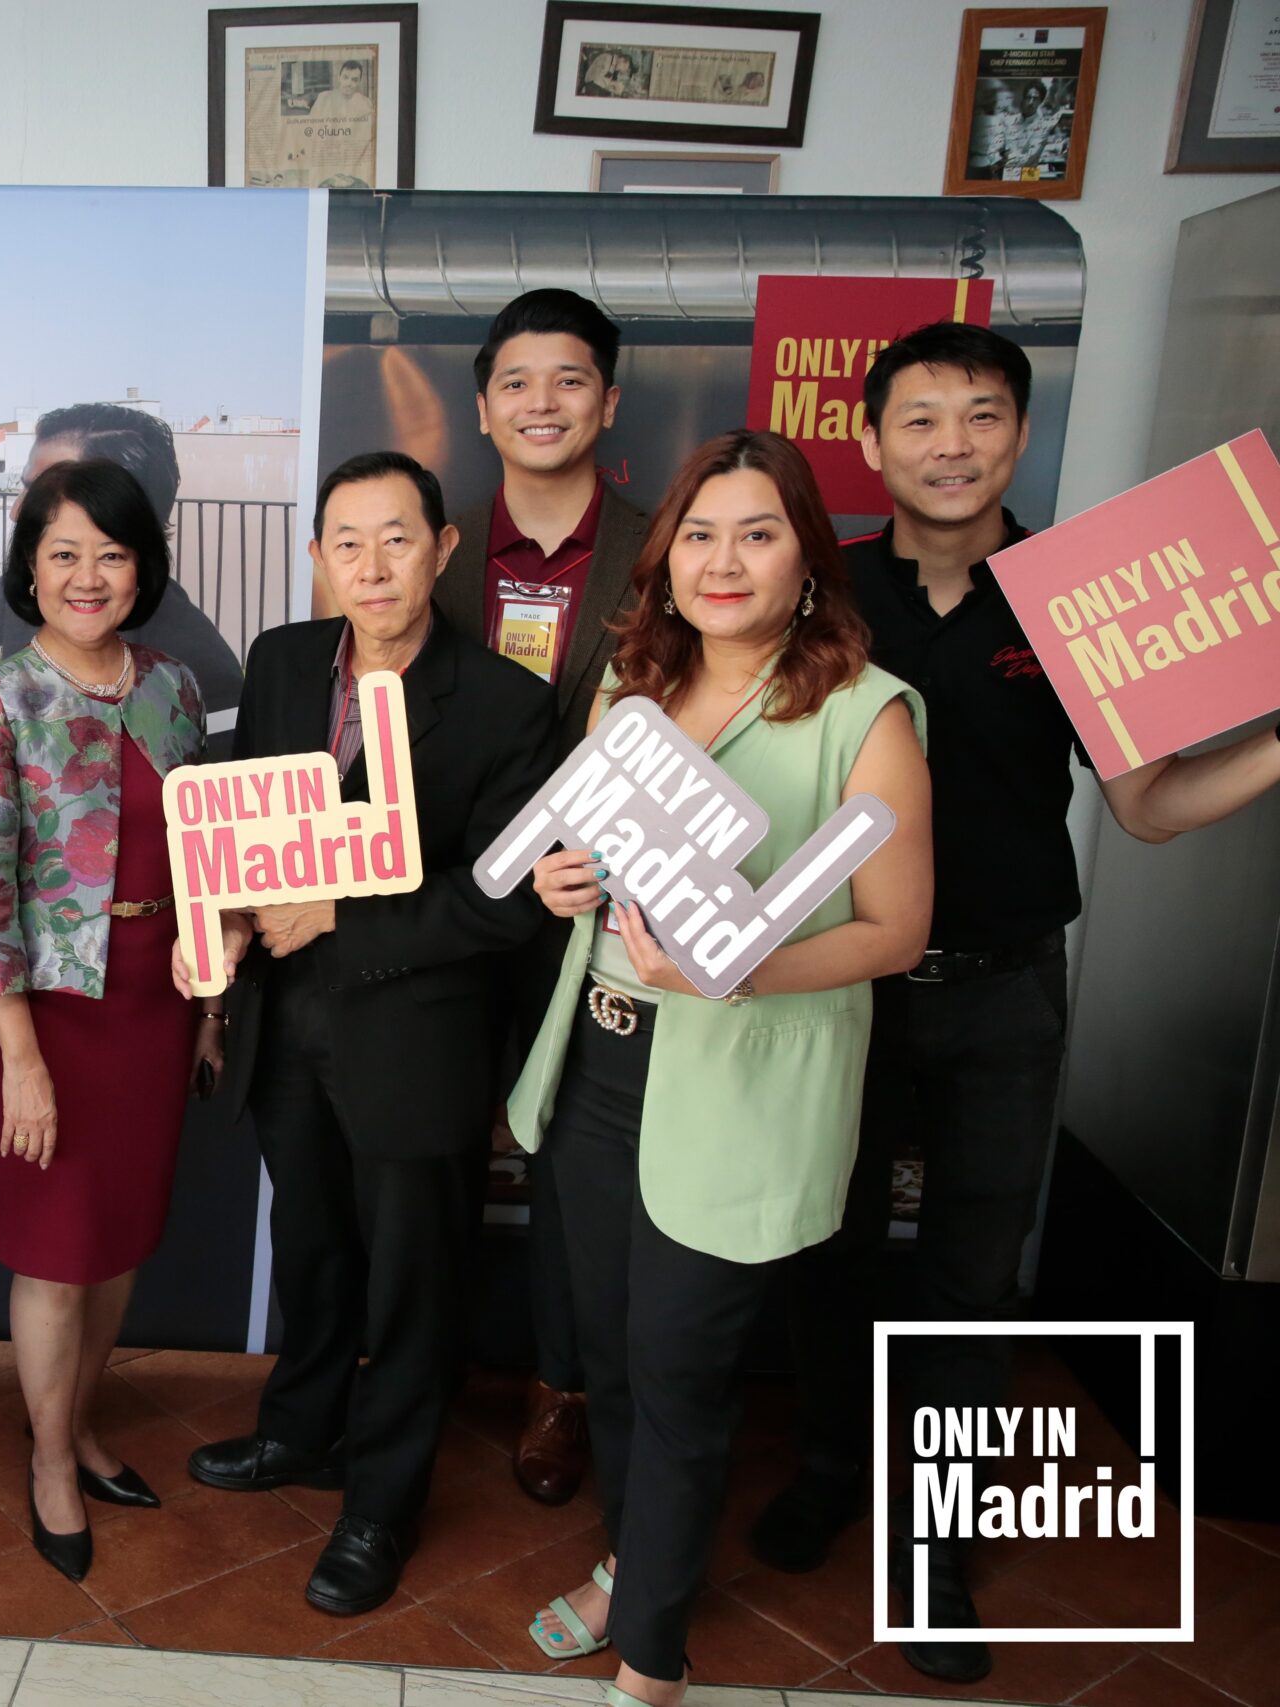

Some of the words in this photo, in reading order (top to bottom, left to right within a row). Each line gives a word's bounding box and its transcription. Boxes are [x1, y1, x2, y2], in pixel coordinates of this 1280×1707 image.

[775, 337, 862, 378] ONLY
[1047, 559, 1150, 637] ONLY
[1148, 537, 1206, 592] IN
[504, 642, 548, 657] Madrid
[506, 632, 526, 643] ONLY
[527, 633, 536, 643] IN
[177, 772, 274, 826] ONLY
[283, 767, 326, 815] IN
[603, 711, 711, 816] ONLY
[684, 792, 750, 860] IN
[181, 809, 407, 898] Madrid
[548, 749, 769, 980] Madrid
